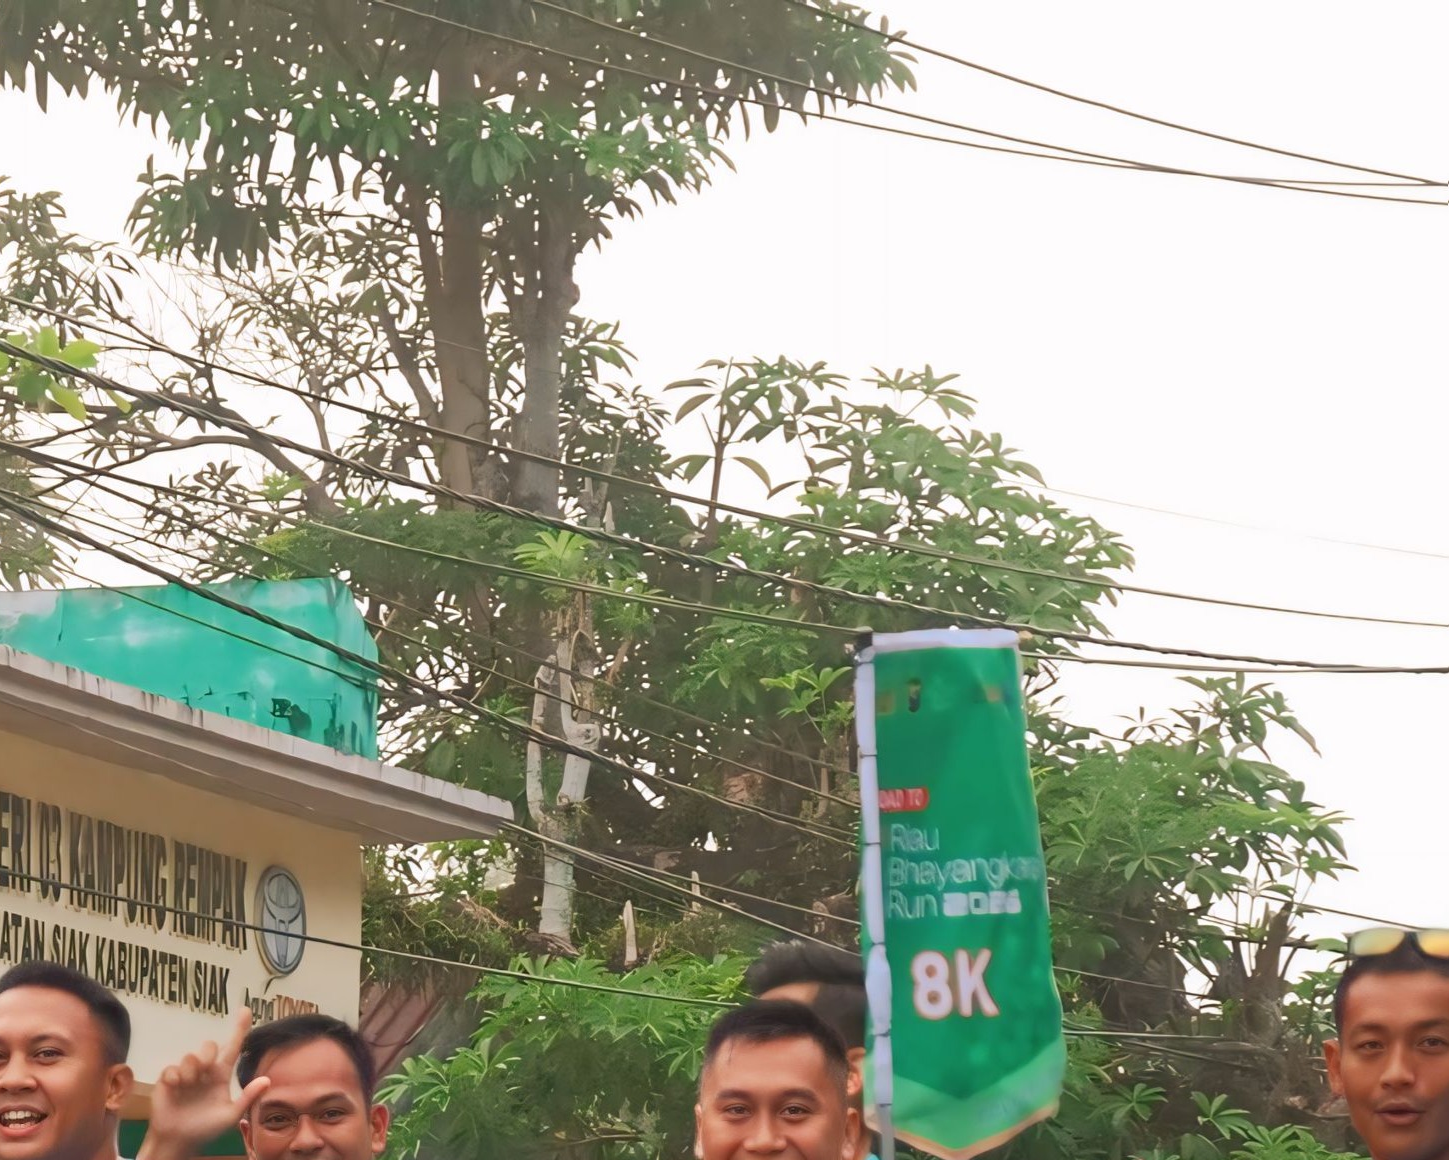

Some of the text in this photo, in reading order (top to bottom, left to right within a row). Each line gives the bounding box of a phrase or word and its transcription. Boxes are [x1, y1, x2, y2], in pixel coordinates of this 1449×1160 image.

[891, 823, 940, 852] Riau
[38, 801, 62, 900] 03
[69, 811, 167, 931] KAMPUNG
[173, 839, 248, 951] REMPAK
[888, 888, 939, 919] Run
[52, 924, 89, 978] SIAK
[95, 935, 188, 1005] KABUPATEN
[193, 960, 230, 1015] SIAK
[911, 948, 1000, 1020] 8K
